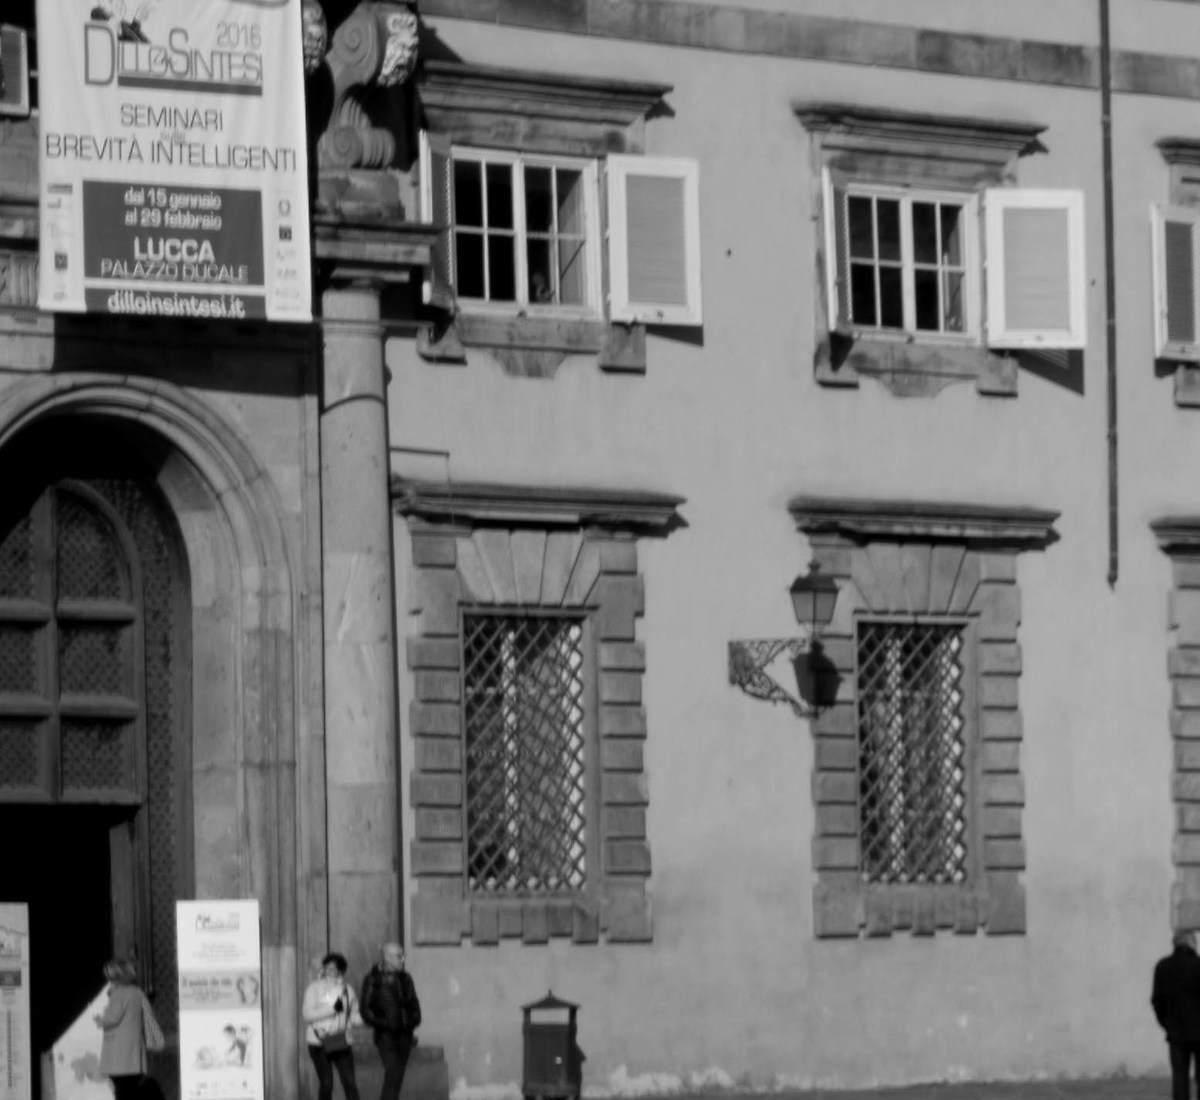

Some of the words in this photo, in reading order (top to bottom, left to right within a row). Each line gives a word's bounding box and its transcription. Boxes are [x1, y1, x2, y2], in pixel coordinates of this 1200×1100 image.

[216, 21, 263, 49] 2016
[120, 103, 224, 132] SEMINARI
[45, 133, 144, 163] BREVITÀ
[151, 139, 297, 171] INTELLIGENTI
[124, 186, 145, 206] dal
[147, 187, 167, 208] 15
[169, 190, 222, 212] gennaio
[124, 207, 138, 227] al
[164, 209, 223, 231] febbraio
[133, 236, 216, 264] LUCCA
[101, 258, 178, 281] PALAZZO
[183, 262, 249, 285] DUCALE
[107, 289, 246, 319] dilloinsintesi.it
